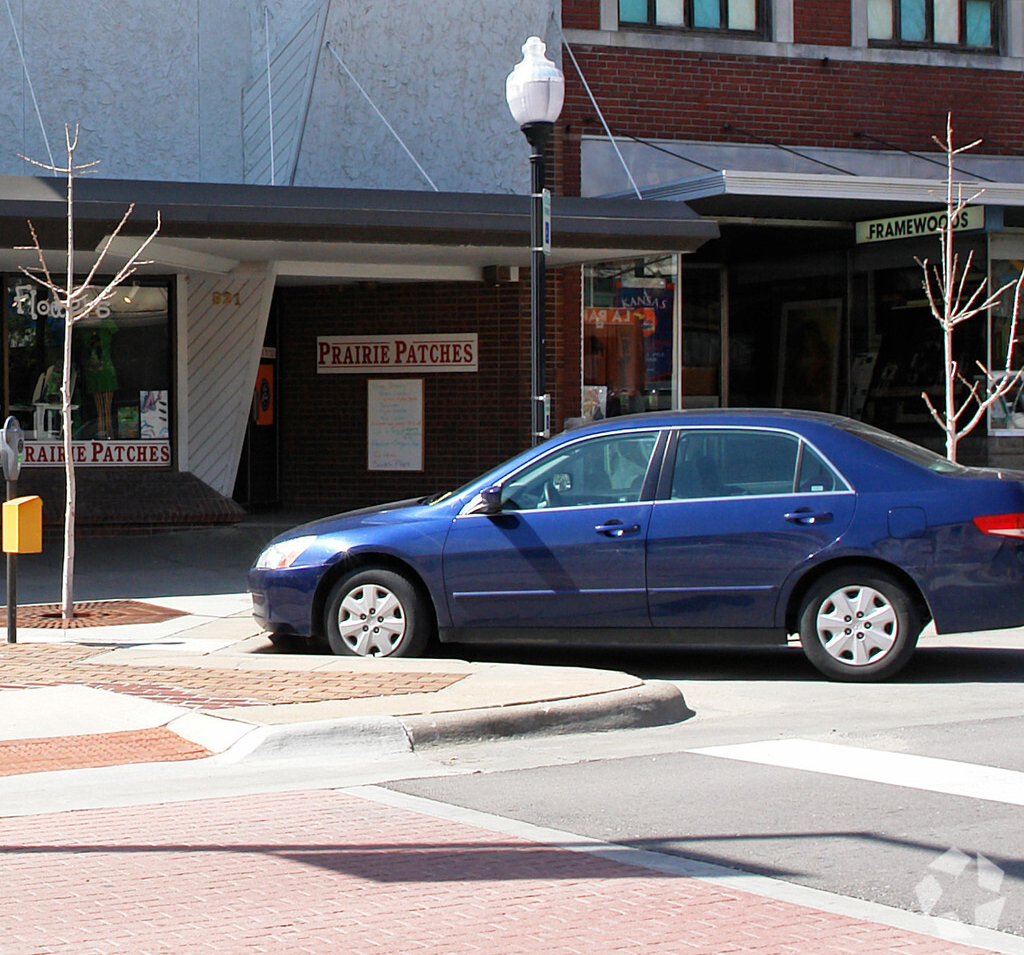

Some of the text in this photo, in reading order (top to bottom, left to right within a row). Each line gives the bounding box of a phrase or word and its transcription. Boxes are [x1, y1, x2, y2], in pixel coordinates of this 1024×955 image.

[621, 289, 667, 309] KANSAS
[318, 340, 473, 365] PRAIRIE PATCHES
[91, 442, 170, 462] PATCHES
